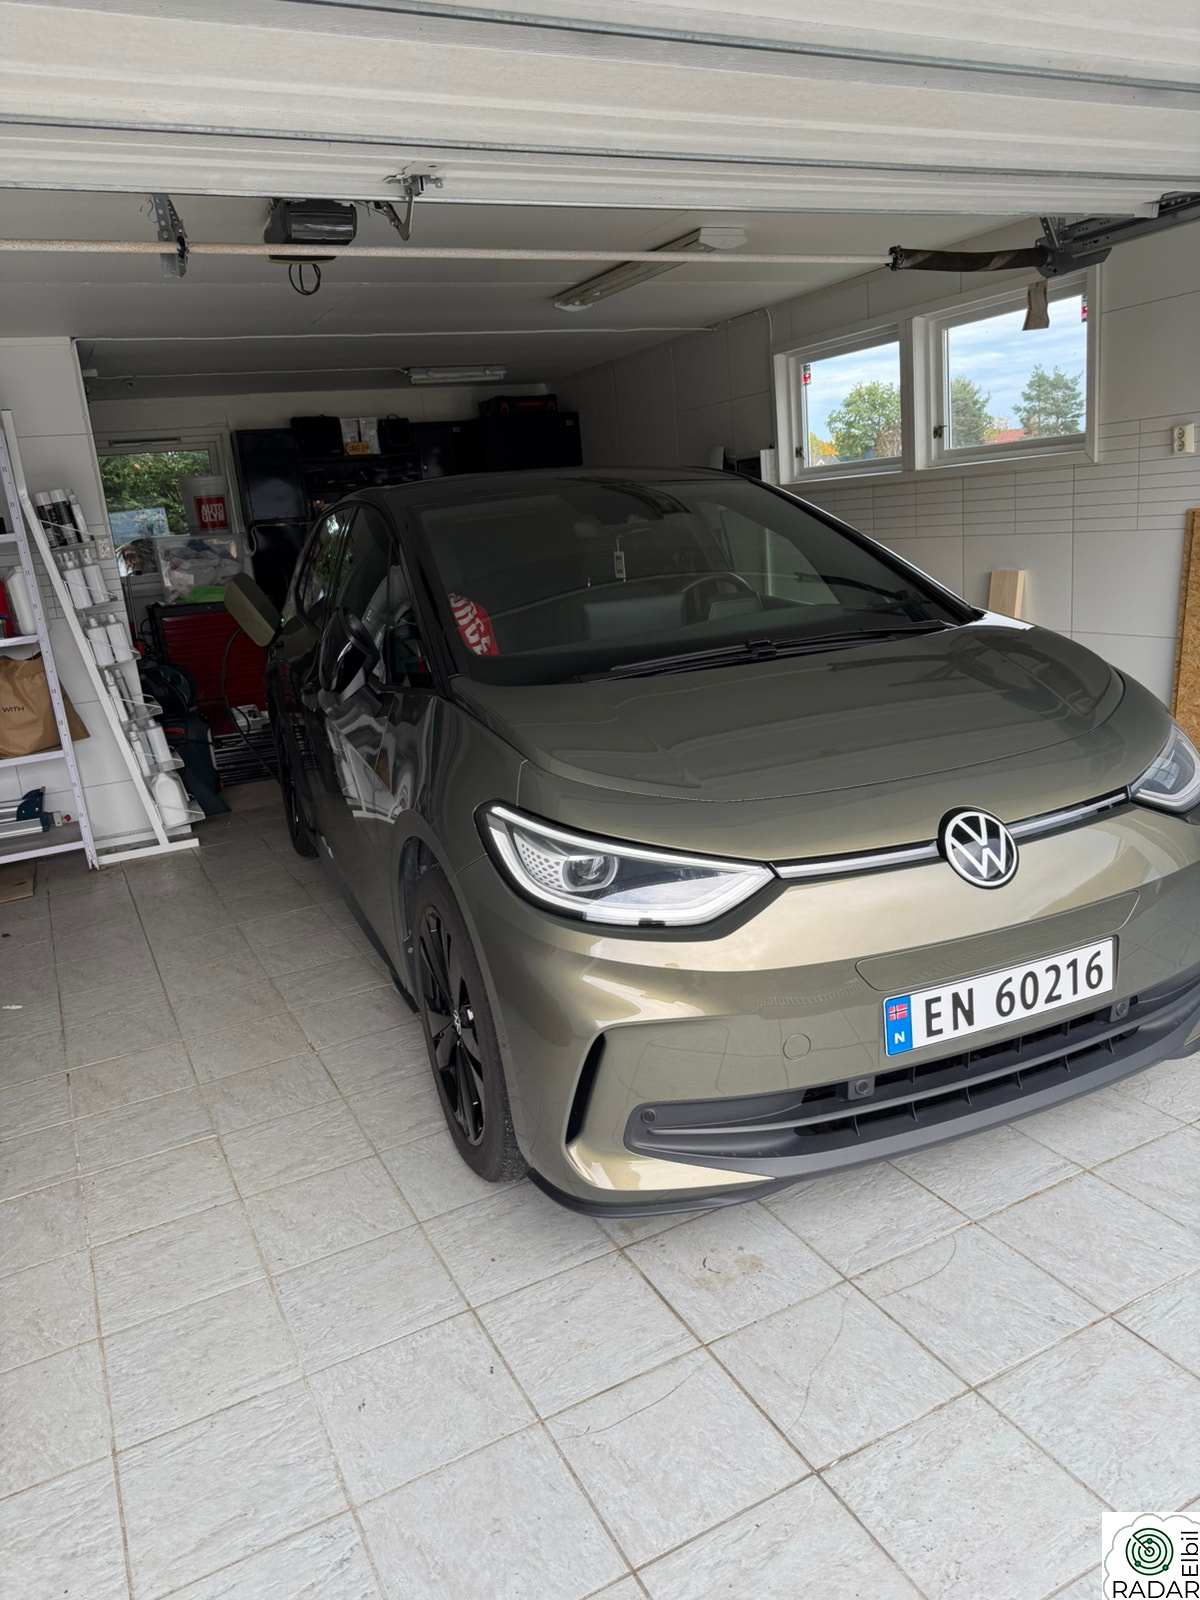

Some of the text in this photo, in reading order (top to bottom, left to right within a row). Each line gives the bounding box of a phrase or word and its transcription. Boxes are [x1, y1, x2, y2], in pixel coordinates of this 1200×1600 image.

[201, 503, 224, 514] AUTO
[925, 950, 1104, 1038] EN 60216
[894, 1031, 906, 1044] N
